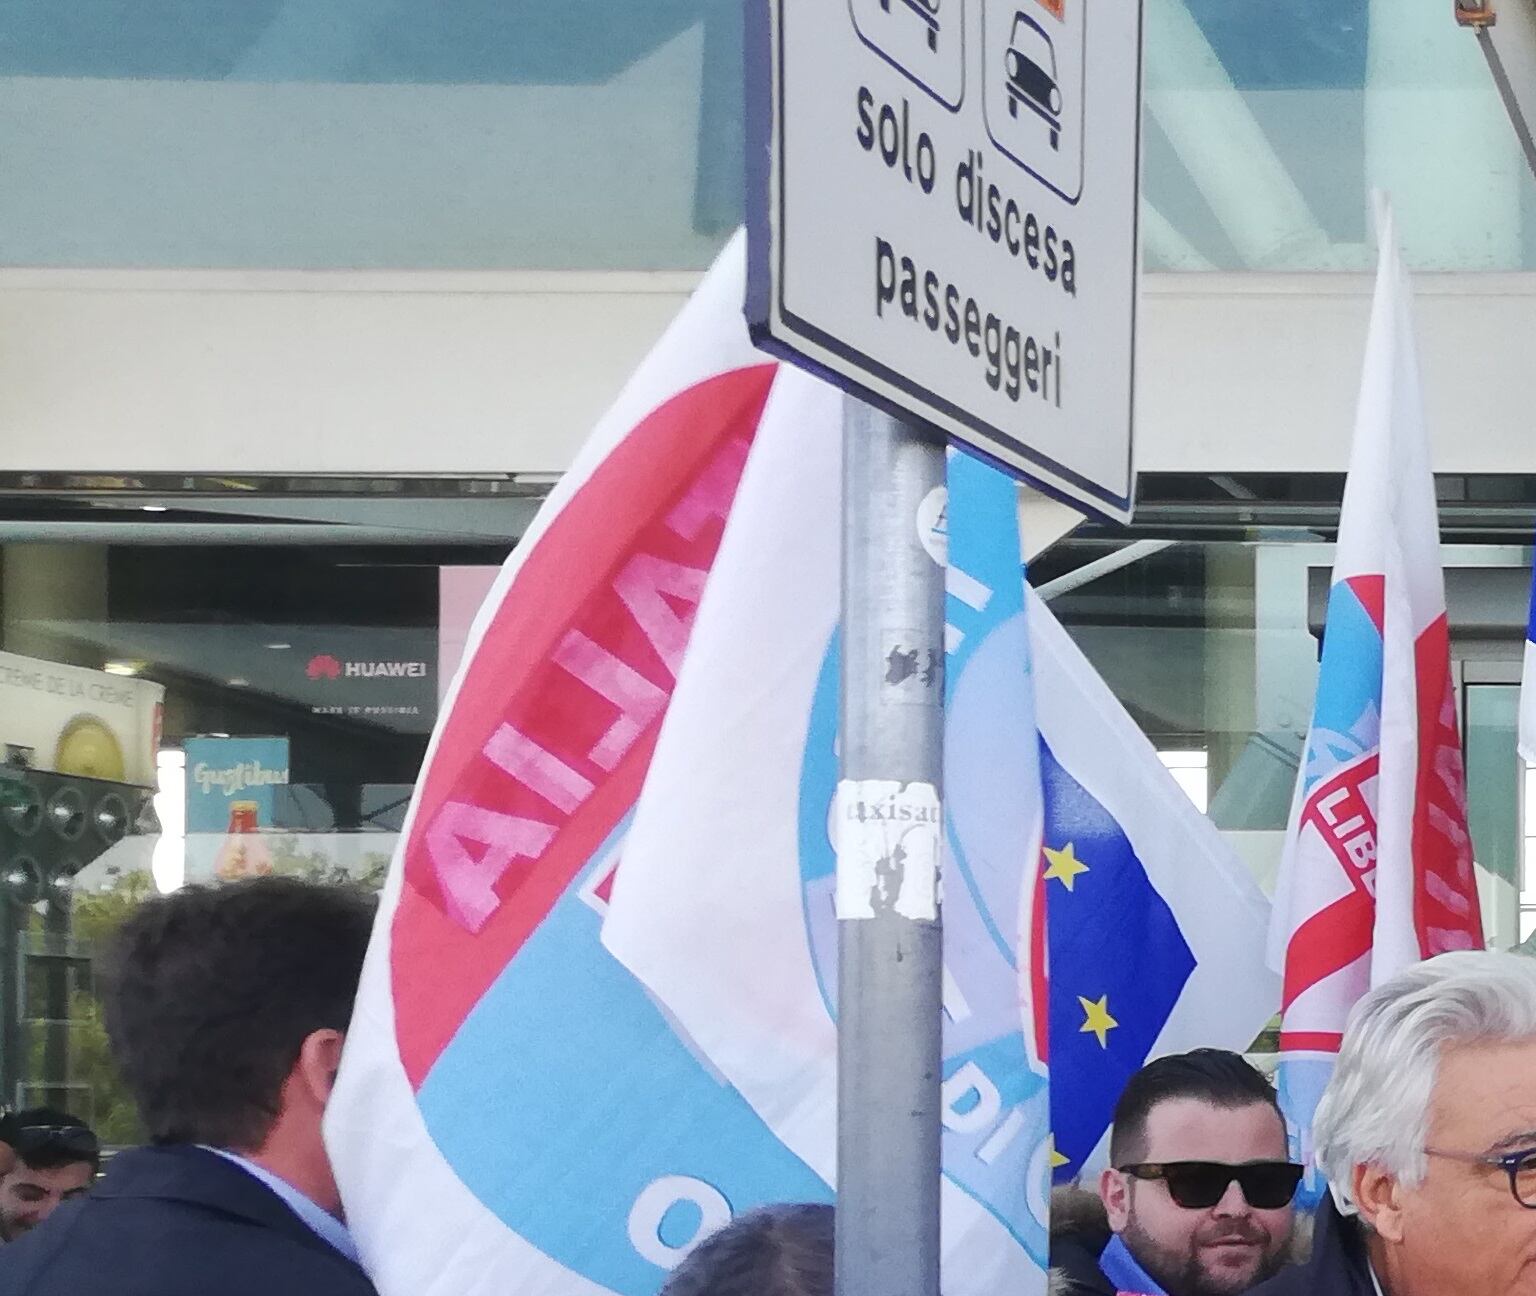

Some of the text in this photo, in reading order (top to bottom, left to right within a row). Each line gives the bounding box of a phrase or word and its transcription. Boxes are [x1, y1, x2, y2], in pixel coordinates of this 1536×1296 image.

[857, 86, 1078, 298] solo discesa
[875, 236, 1063, 409] passeggeri
[345, 662, 427, 677] HUAWEI
